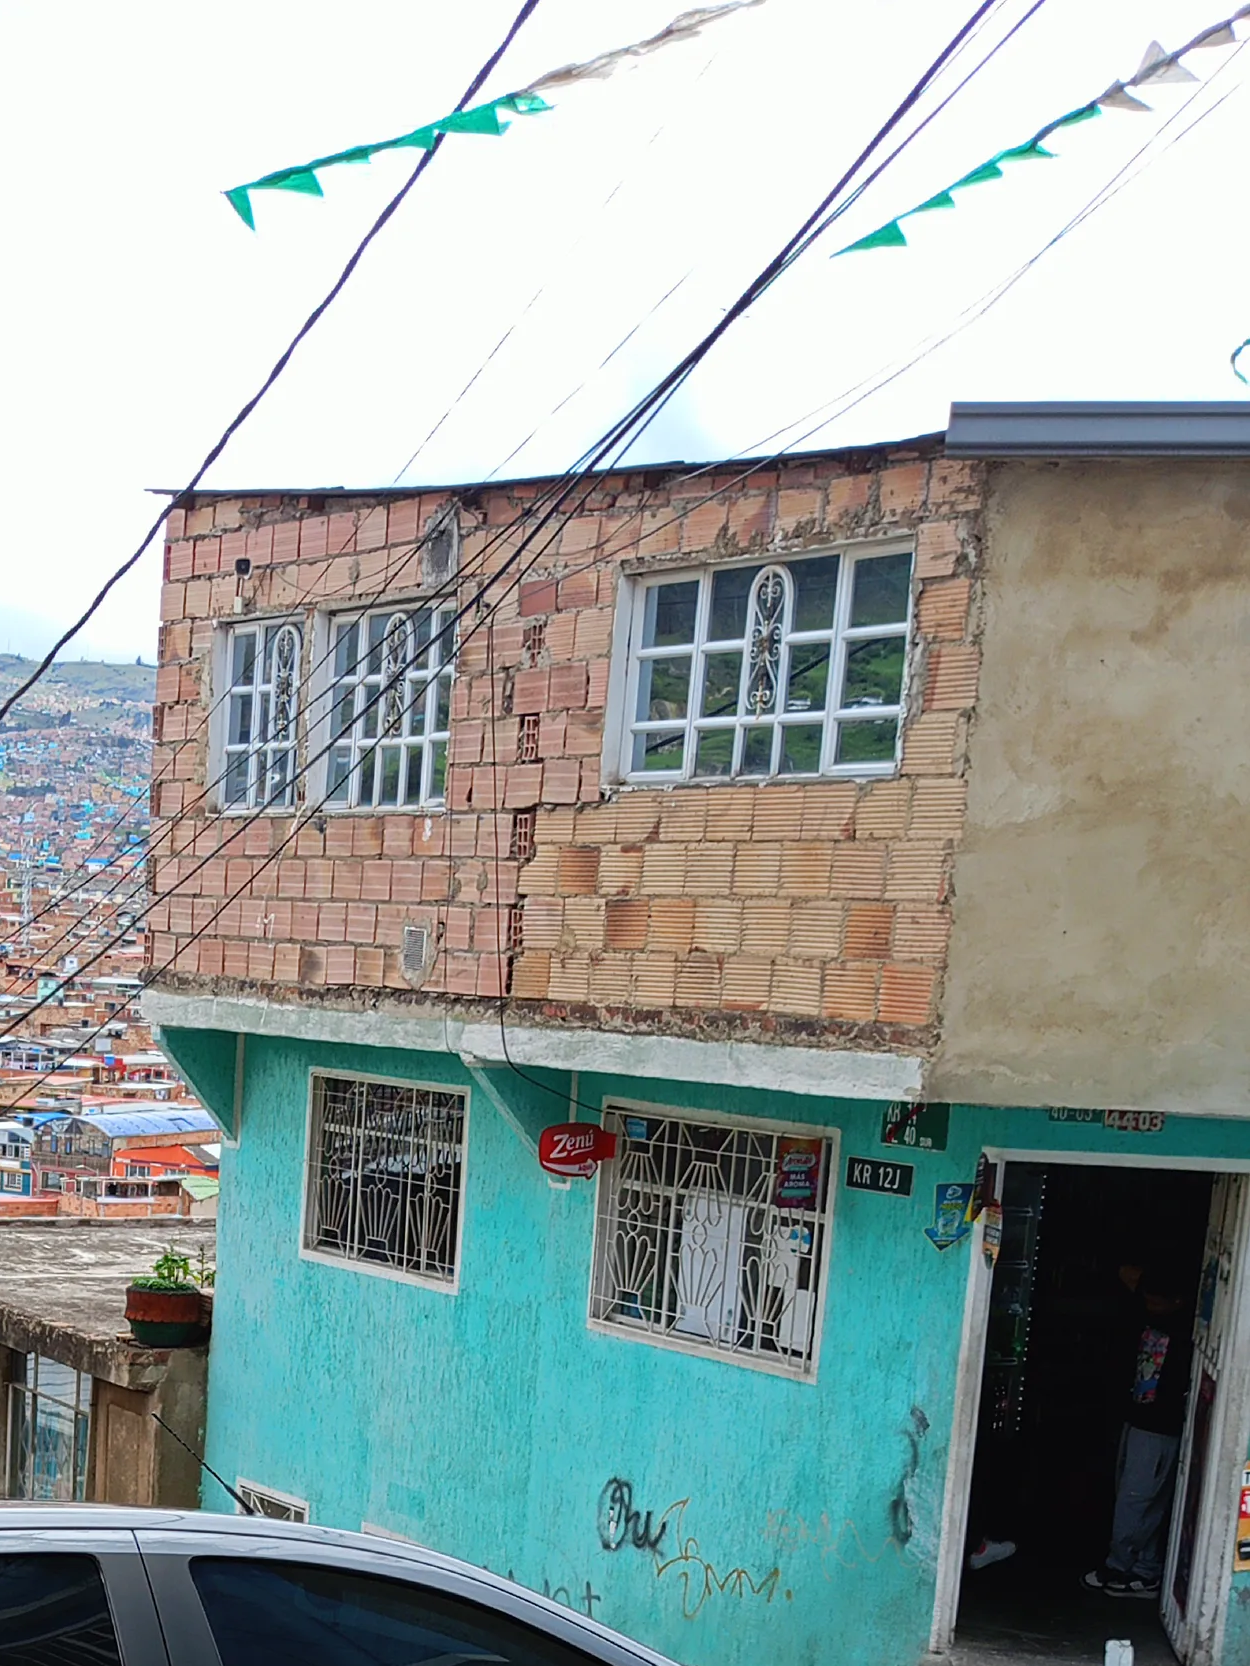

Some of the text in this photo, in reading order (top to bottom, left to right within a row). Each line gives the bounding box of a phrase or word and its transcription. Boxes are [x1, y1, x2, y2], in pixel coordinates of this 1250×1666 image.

[550, 1128, 594, 1159] Zenú
[903, 1125, 916, 1145] 40
[783, 1180, 810, 1188] AROMA
[853, 1162, 901, 1189] KR 12J
